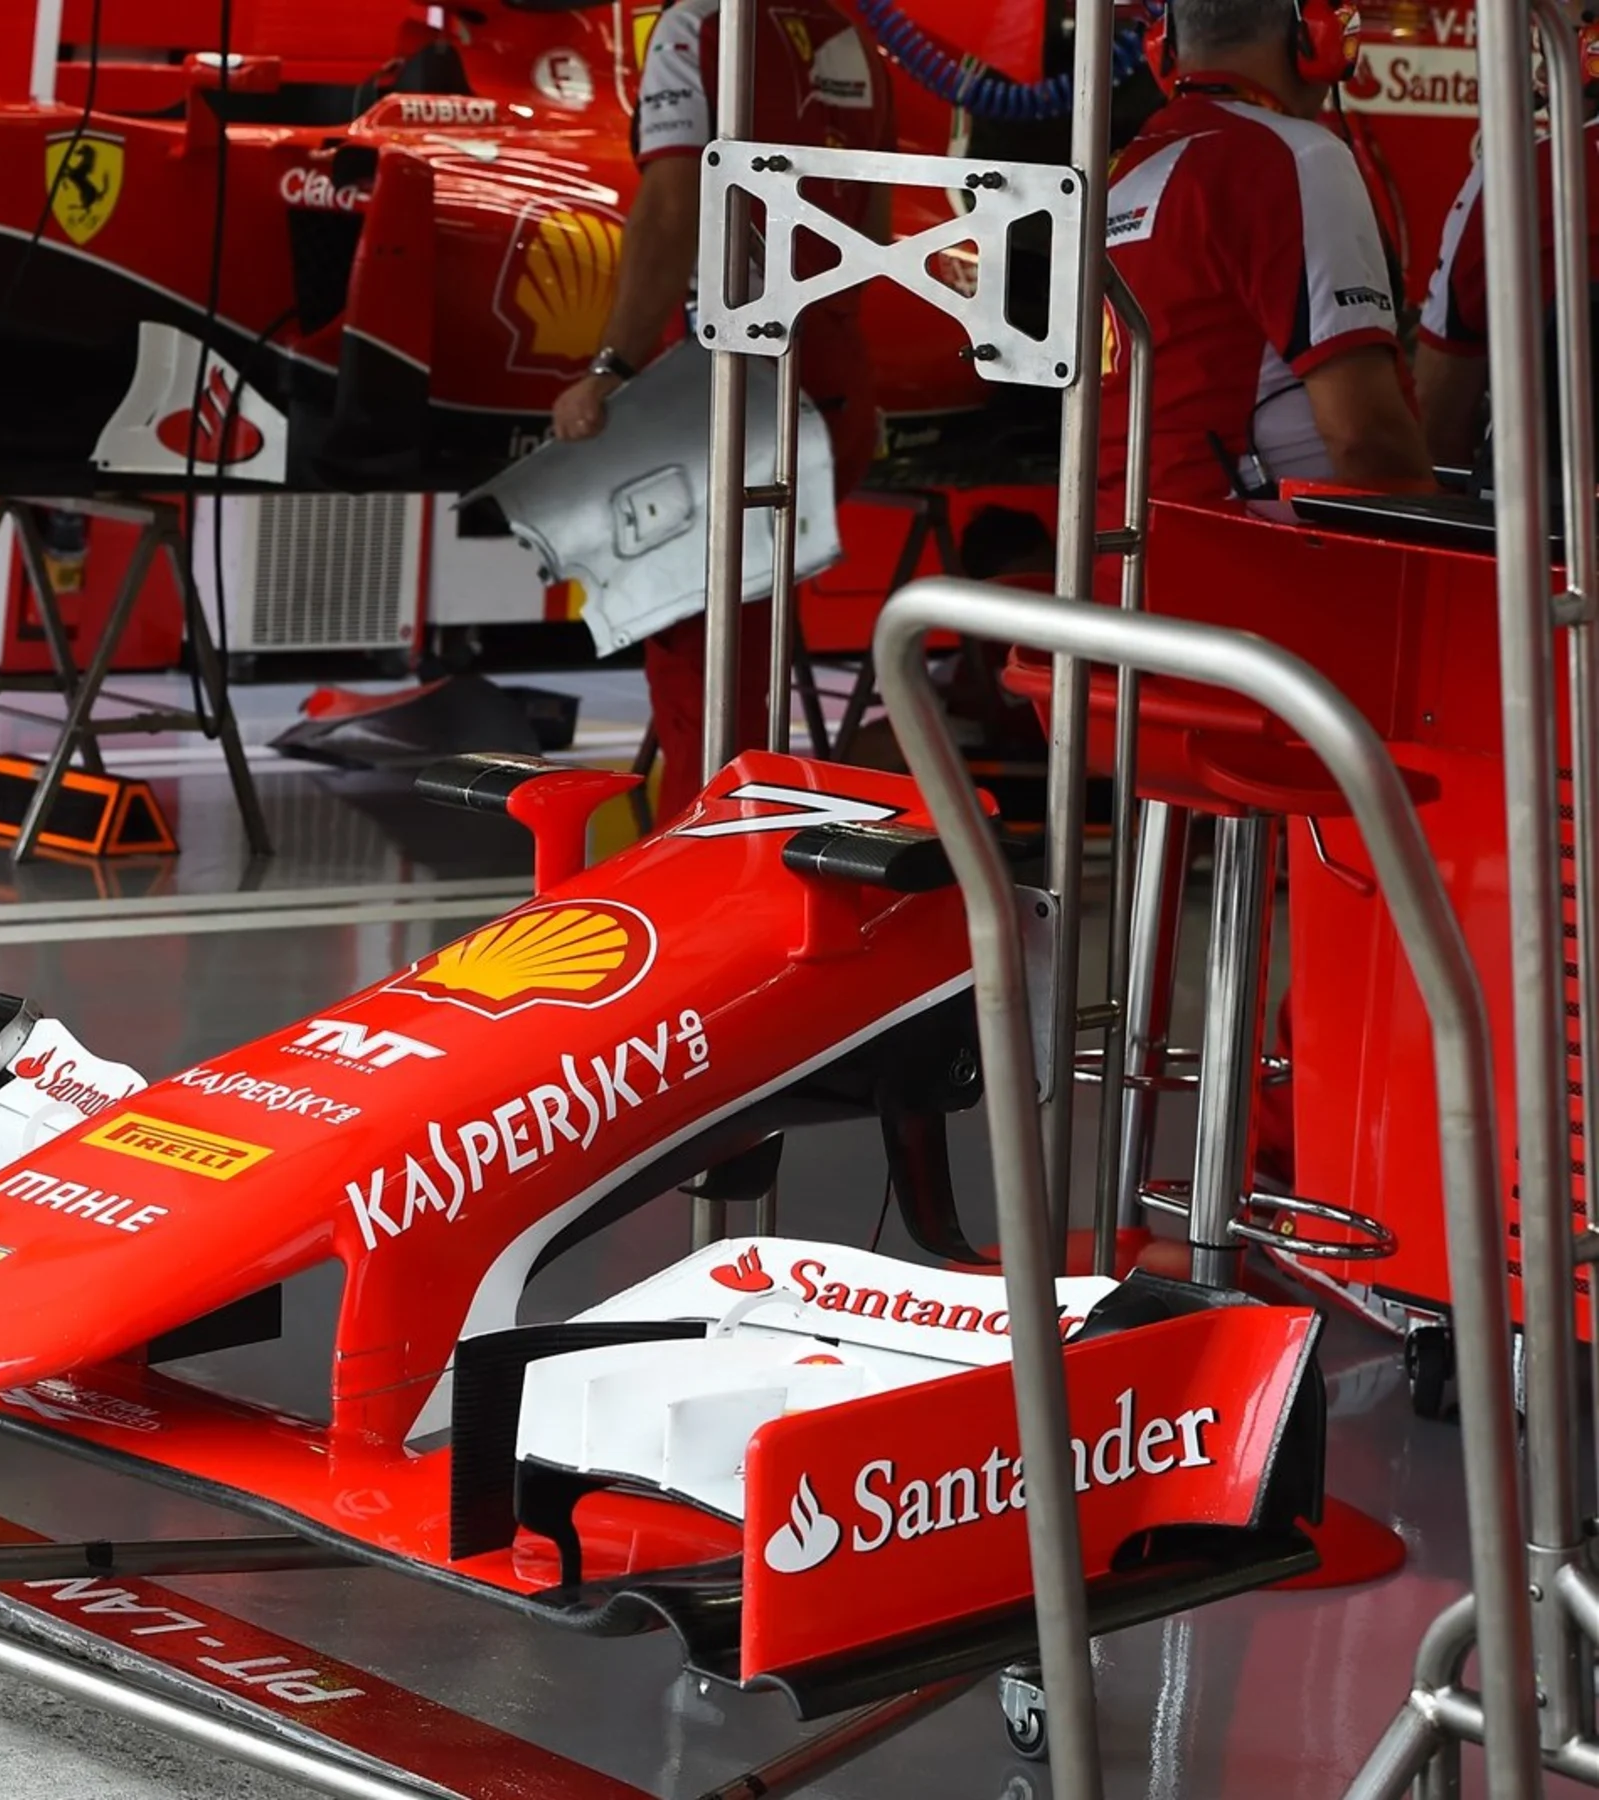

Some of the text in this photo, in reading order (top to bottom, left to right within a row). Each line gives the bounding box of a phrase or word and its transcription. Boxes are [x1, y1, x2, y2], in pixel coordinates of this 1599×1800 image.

[401, 100, 496, 123] HUBLOT
[670, 782, 900, 838] 7
[279, 1046, 377, 1075] ENERGY DRINK
[292, 1019, 447, 1069] TNT
[171, 1067, 346, 1122] KASPERSKY
[104, 1122, 249, 1170] PIRELLI
[345, 1008, 710, 1252] KASPERSKY lab
[790, 1258, 1084, 1340] Santanr
